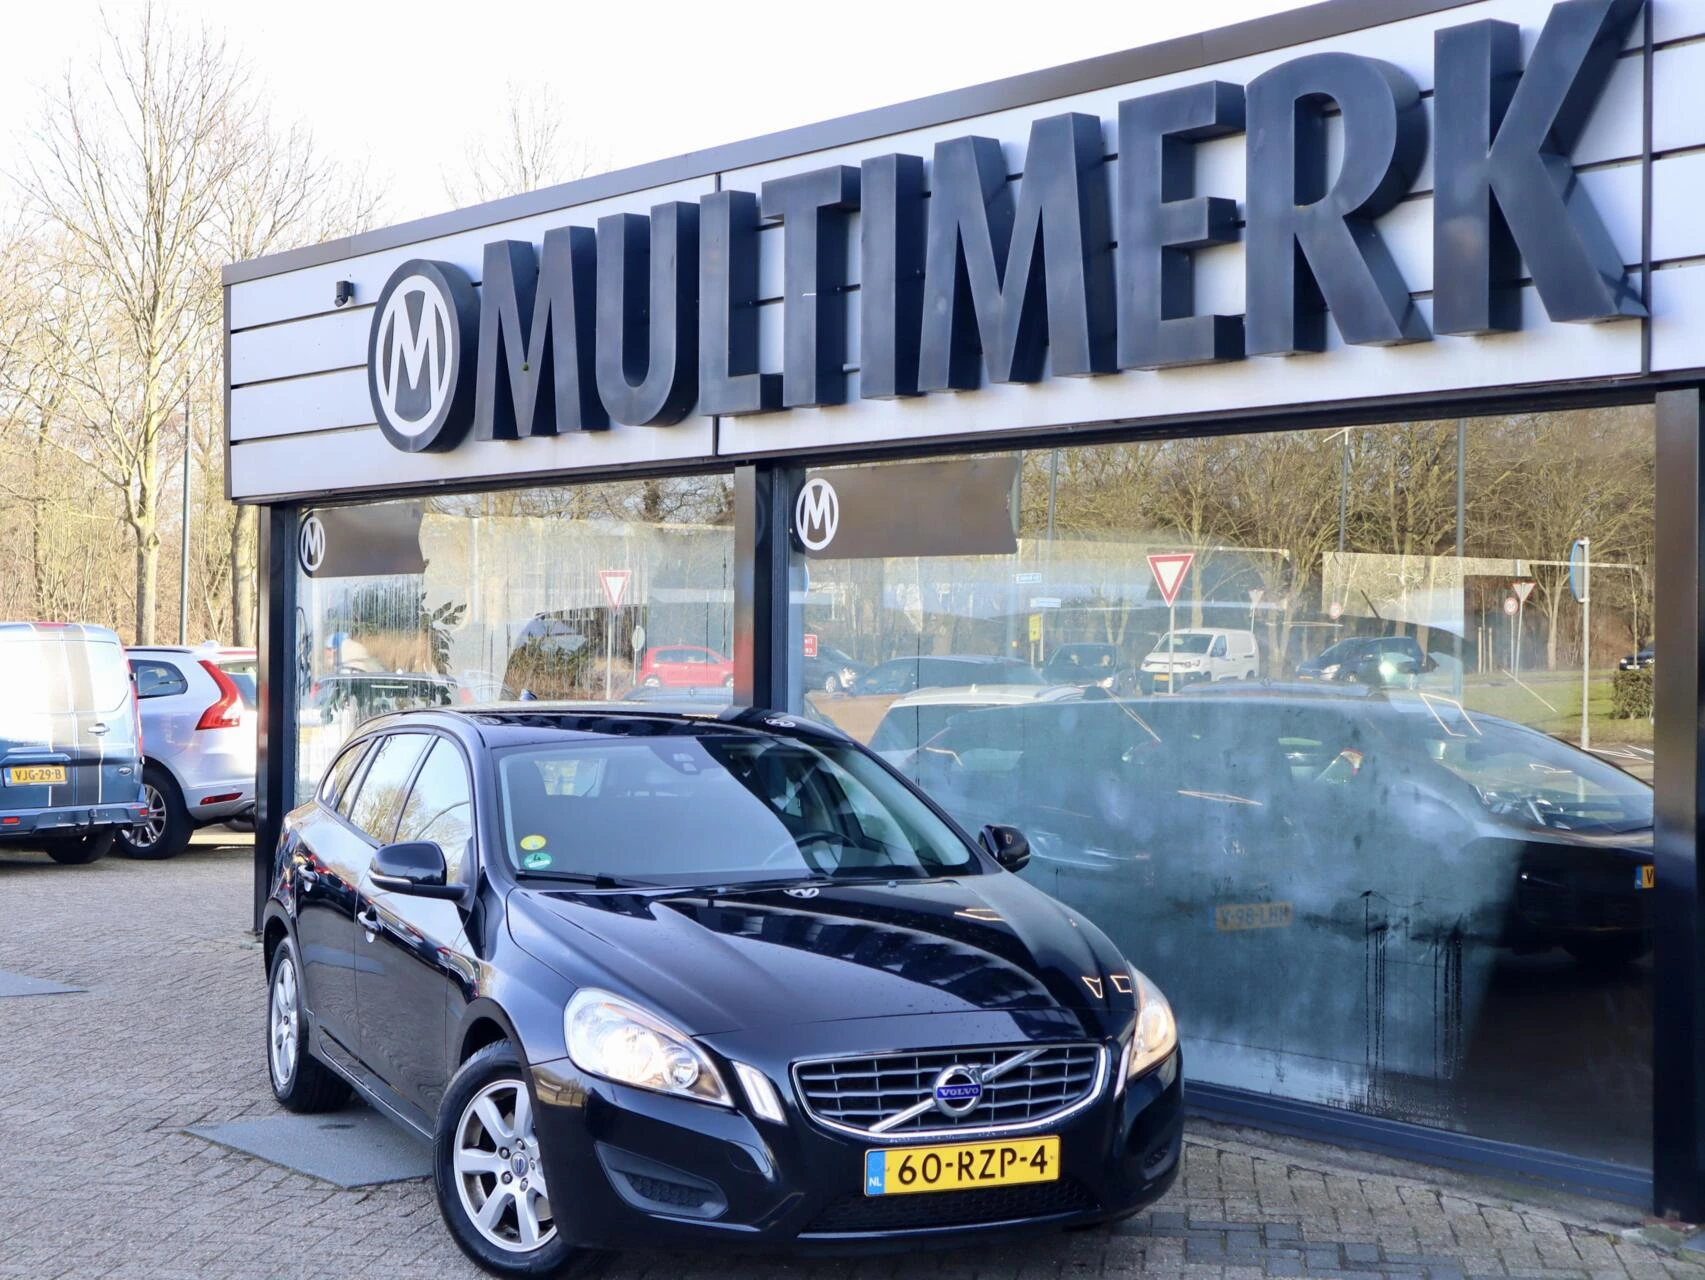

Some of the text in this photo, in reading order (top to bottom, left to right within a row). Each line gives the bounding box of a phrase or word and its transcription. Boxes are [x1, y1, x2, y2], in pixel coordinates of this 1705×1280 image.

[376, 0, 1645, 441] M MULTIMERK
[15, 768, 62, 781] VJG-29-B
[939, 1086, 979, 1097] VOLVO
[869, 1145, 1048, 1187] NL 60-RZP-4
